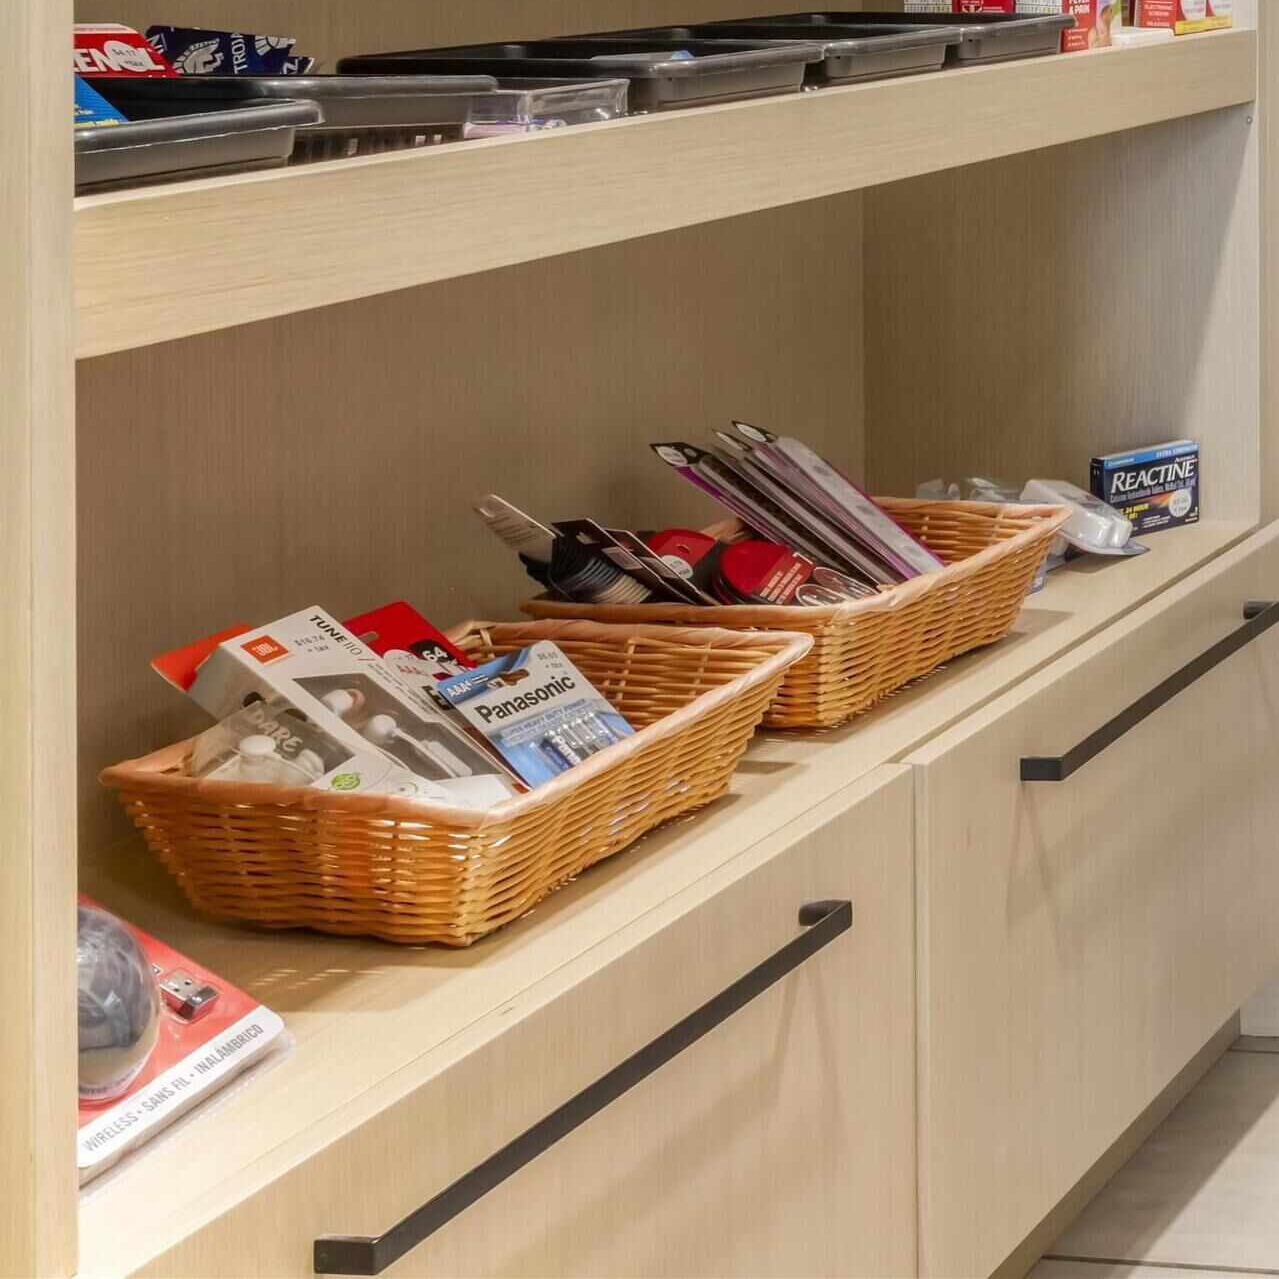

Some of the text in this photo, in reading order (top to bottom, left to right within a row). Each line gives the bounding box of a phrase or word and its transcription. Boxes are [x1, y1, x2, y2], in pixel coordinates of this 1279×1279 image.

[1173, 444, 1198, 455] STRENGTH
[1111, 459, 1194, 494] REACTINE
[310, 615, 348, 643] TUNE
[251, 642, 278, 657] JBL
[421, 646, 448, 663] 64
[474, 675, 576, 725] Panasonic
[82, 1110, 139, 1152] WIRELESS
[141, 1087, 175, 1112] SANS
[174, 1075, 192, 1092] FIL
